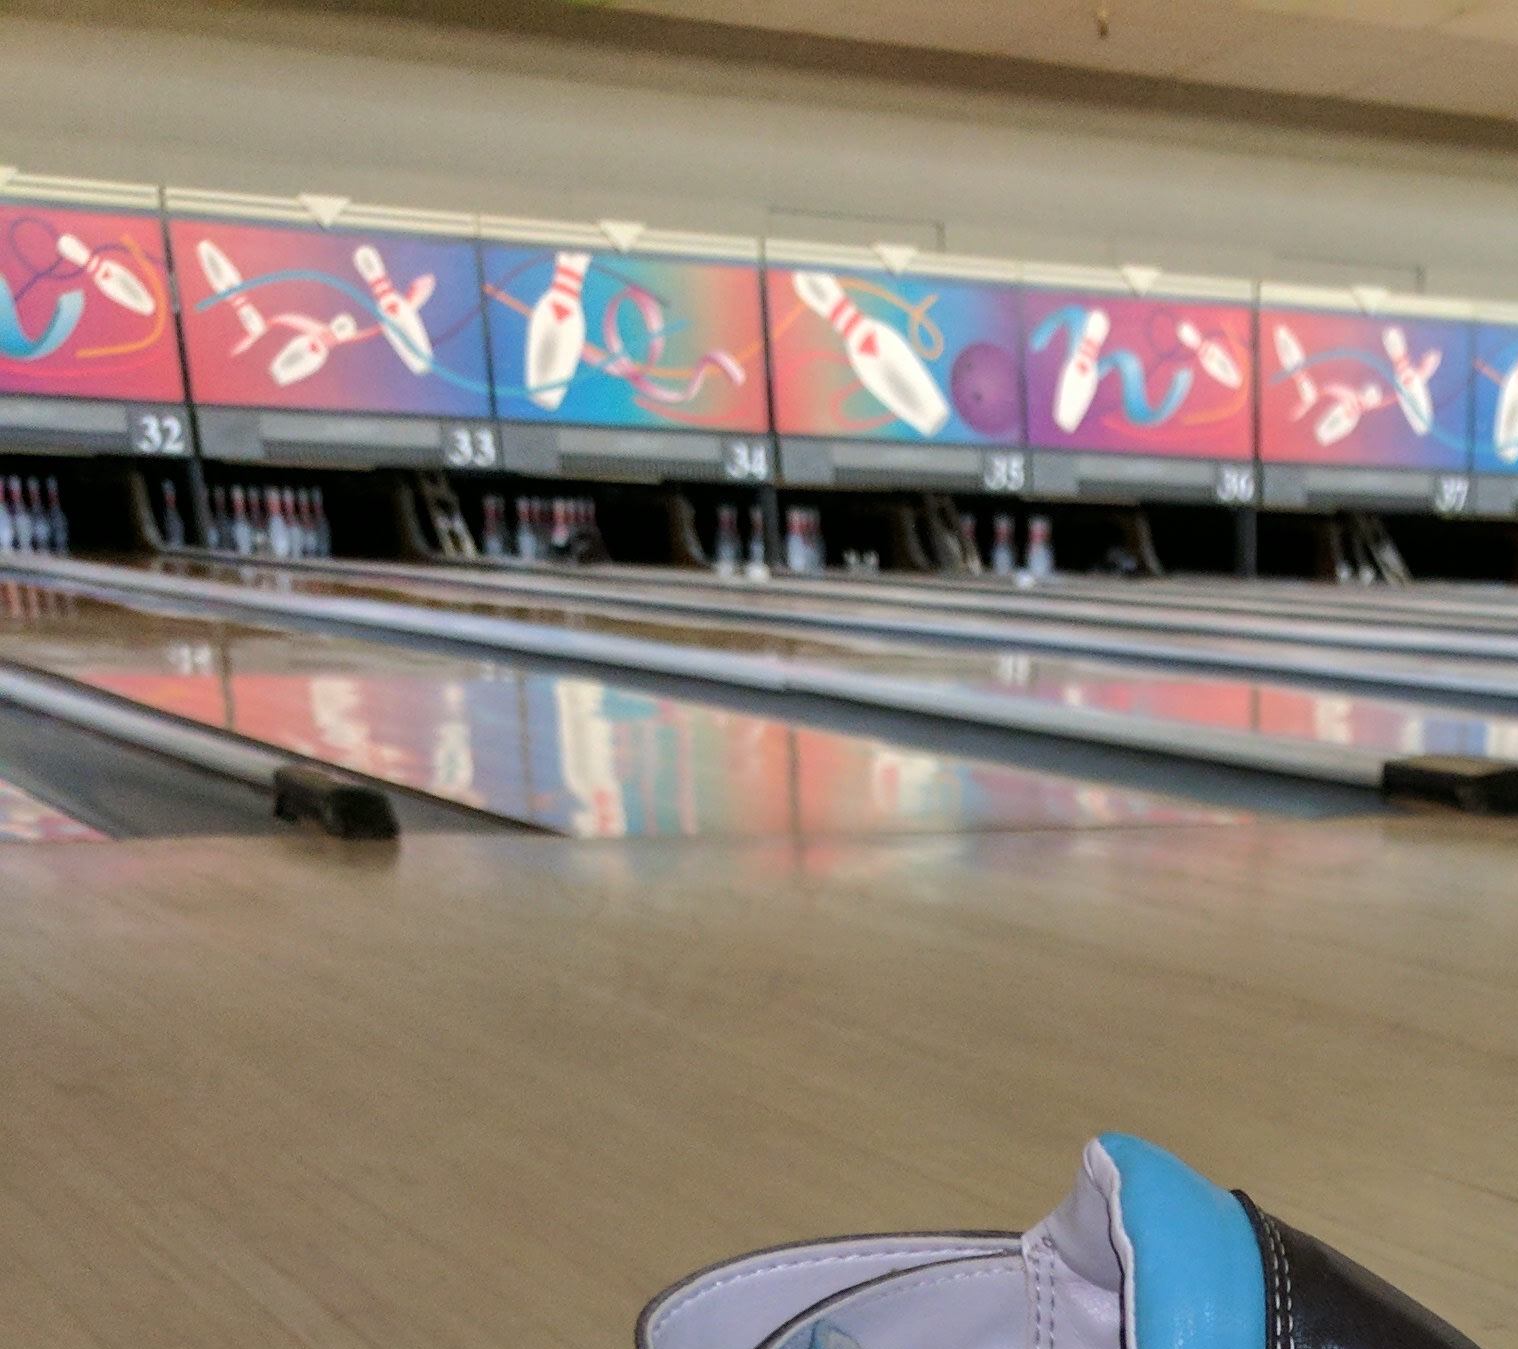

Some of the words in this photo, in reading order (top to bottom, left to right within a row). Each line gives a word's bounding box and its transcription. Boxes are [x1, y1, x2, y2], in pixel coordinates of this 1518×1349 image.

[138, 416, 184, 453] 32
[449, 428, 495, 467] 33
[727, 442, 768, 481] 34
[985, 453, 1025, 491] 35
